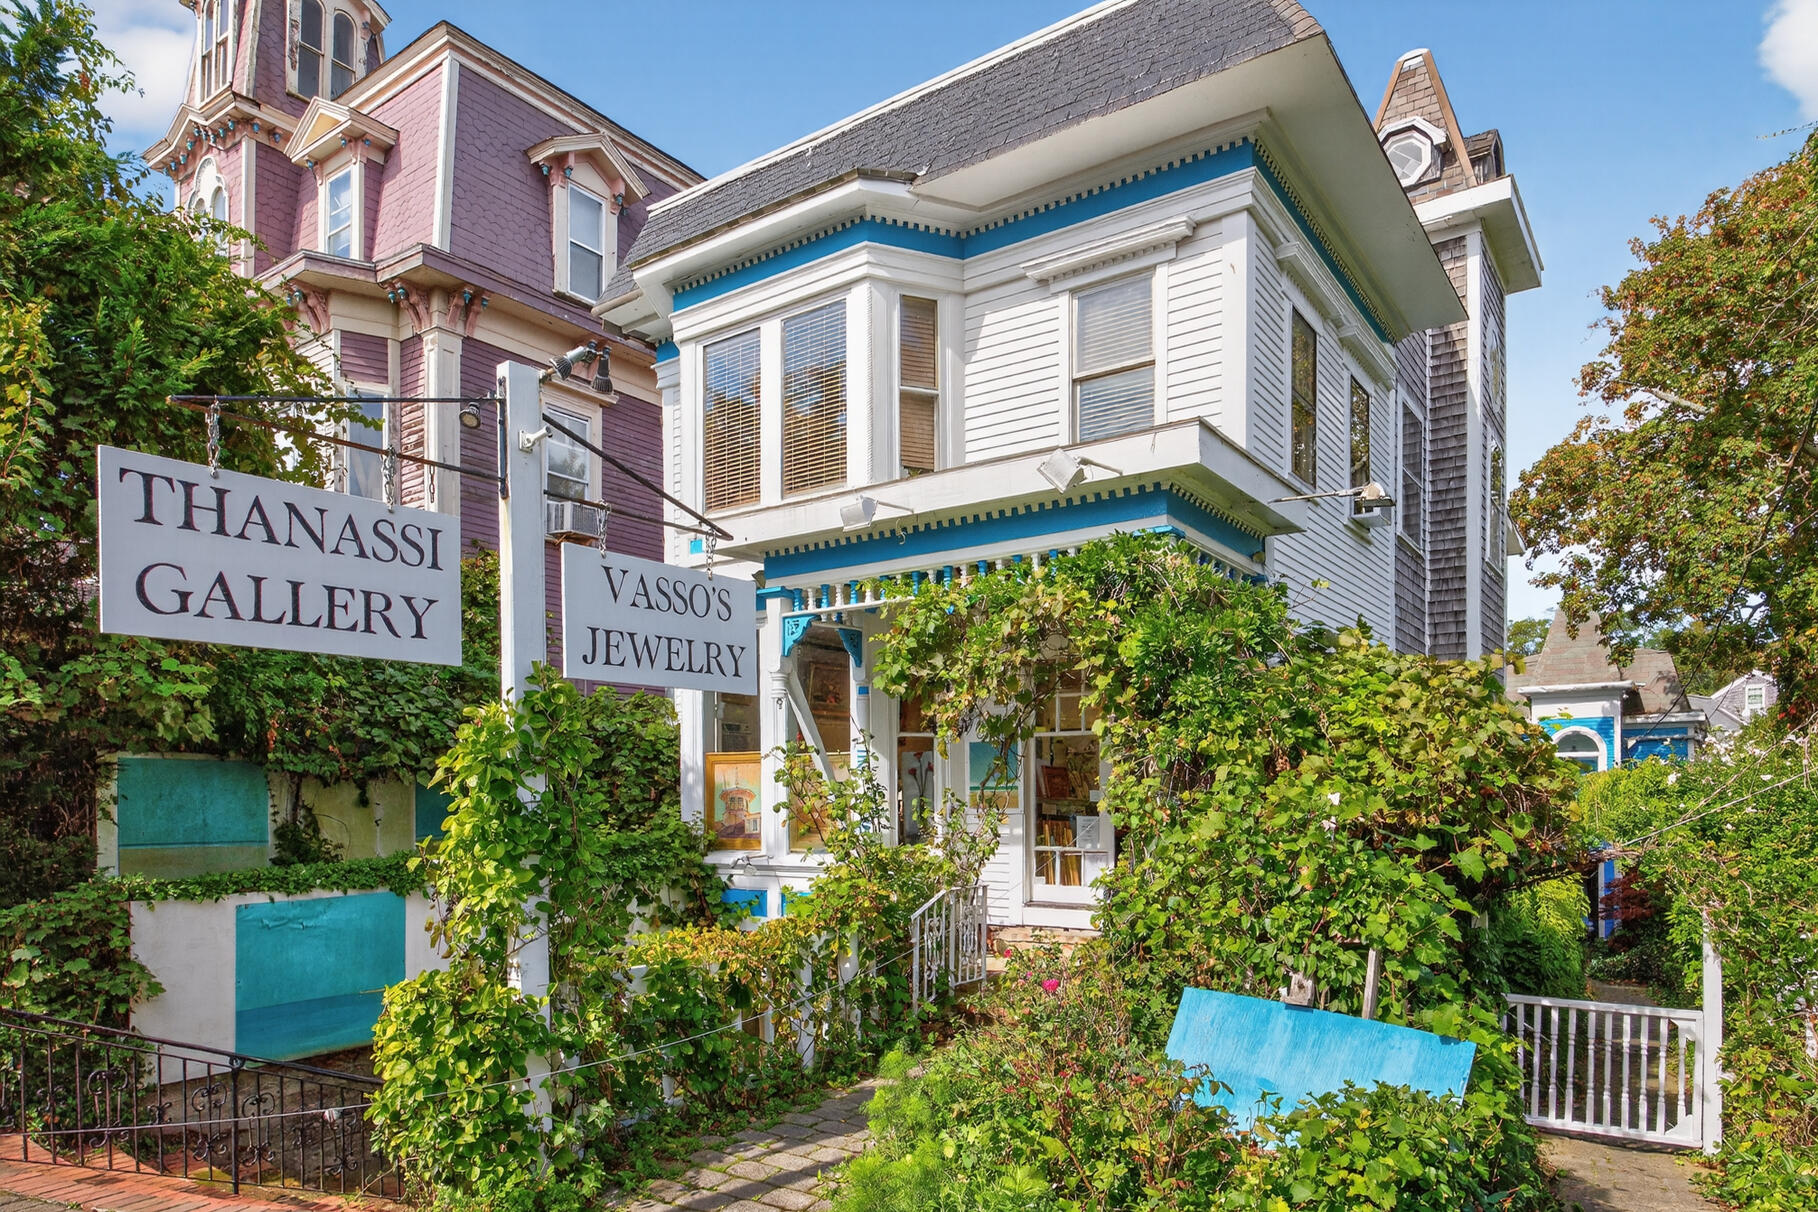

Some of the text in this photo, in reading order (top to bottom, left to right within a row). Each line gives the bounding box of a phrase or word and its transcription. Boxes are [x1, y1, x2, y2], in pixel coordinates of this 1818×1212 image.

[118, 466, 444, 572] THANASSI
[135, 562, 439, 640] GALLERY
[600, 564, 732, 622] VASSO'S
[581, 626, 747, 678] JEWELRY
